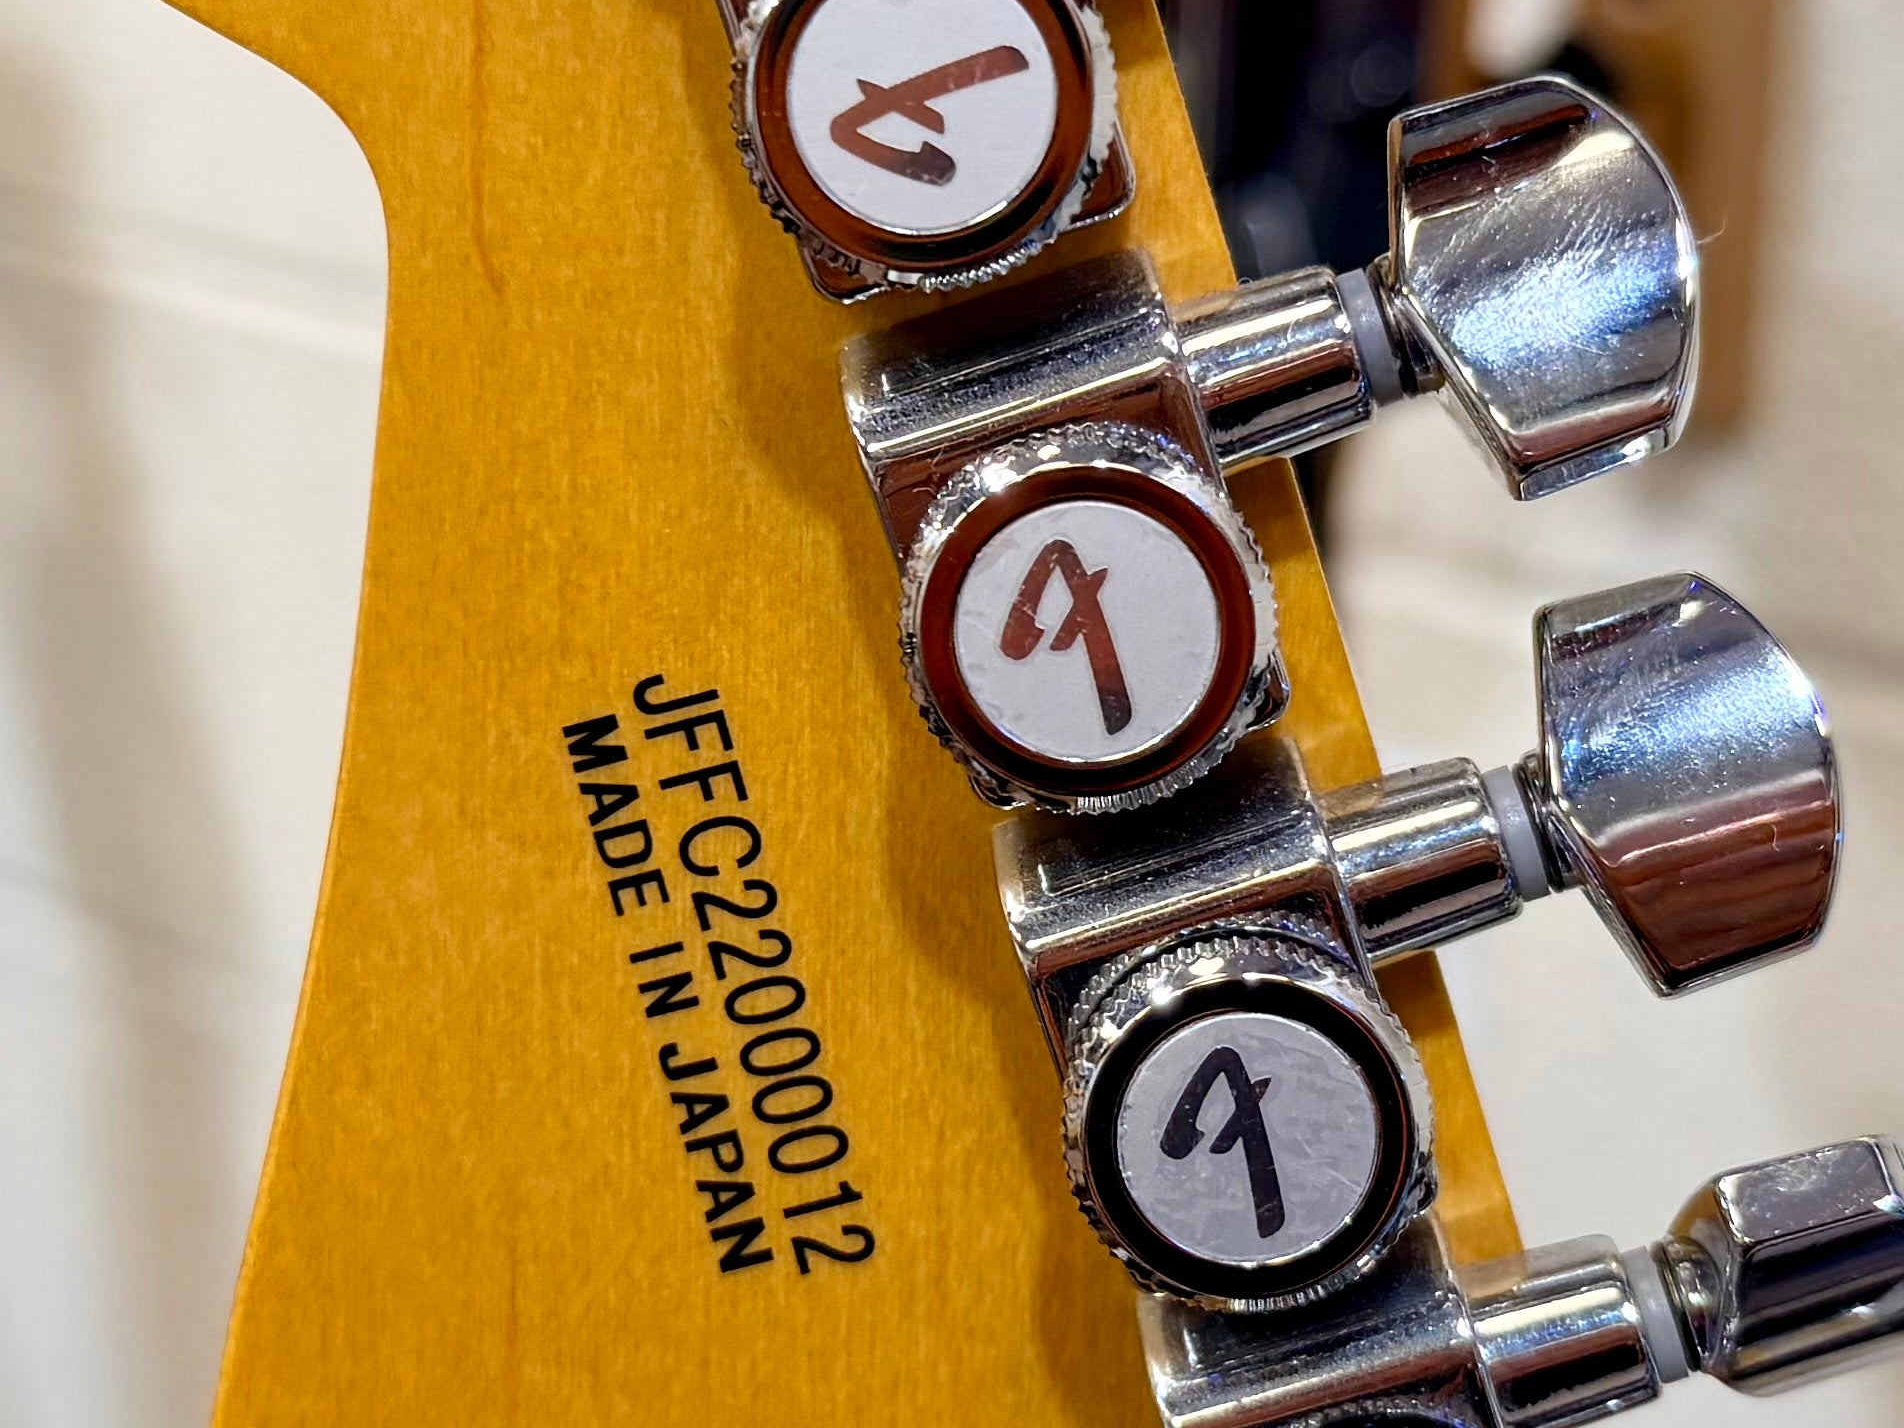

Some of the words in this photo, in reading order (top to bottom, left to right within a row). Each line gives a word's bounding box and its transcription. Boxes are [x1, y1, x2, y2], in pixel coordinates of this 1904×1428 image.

[561, 713, 671, 918] MADE
[628, 941, 700, 1019] IN
[632, 673, 876, 1276] JFFC22000012
[658, 1042, 775, 1274] JAPAN
